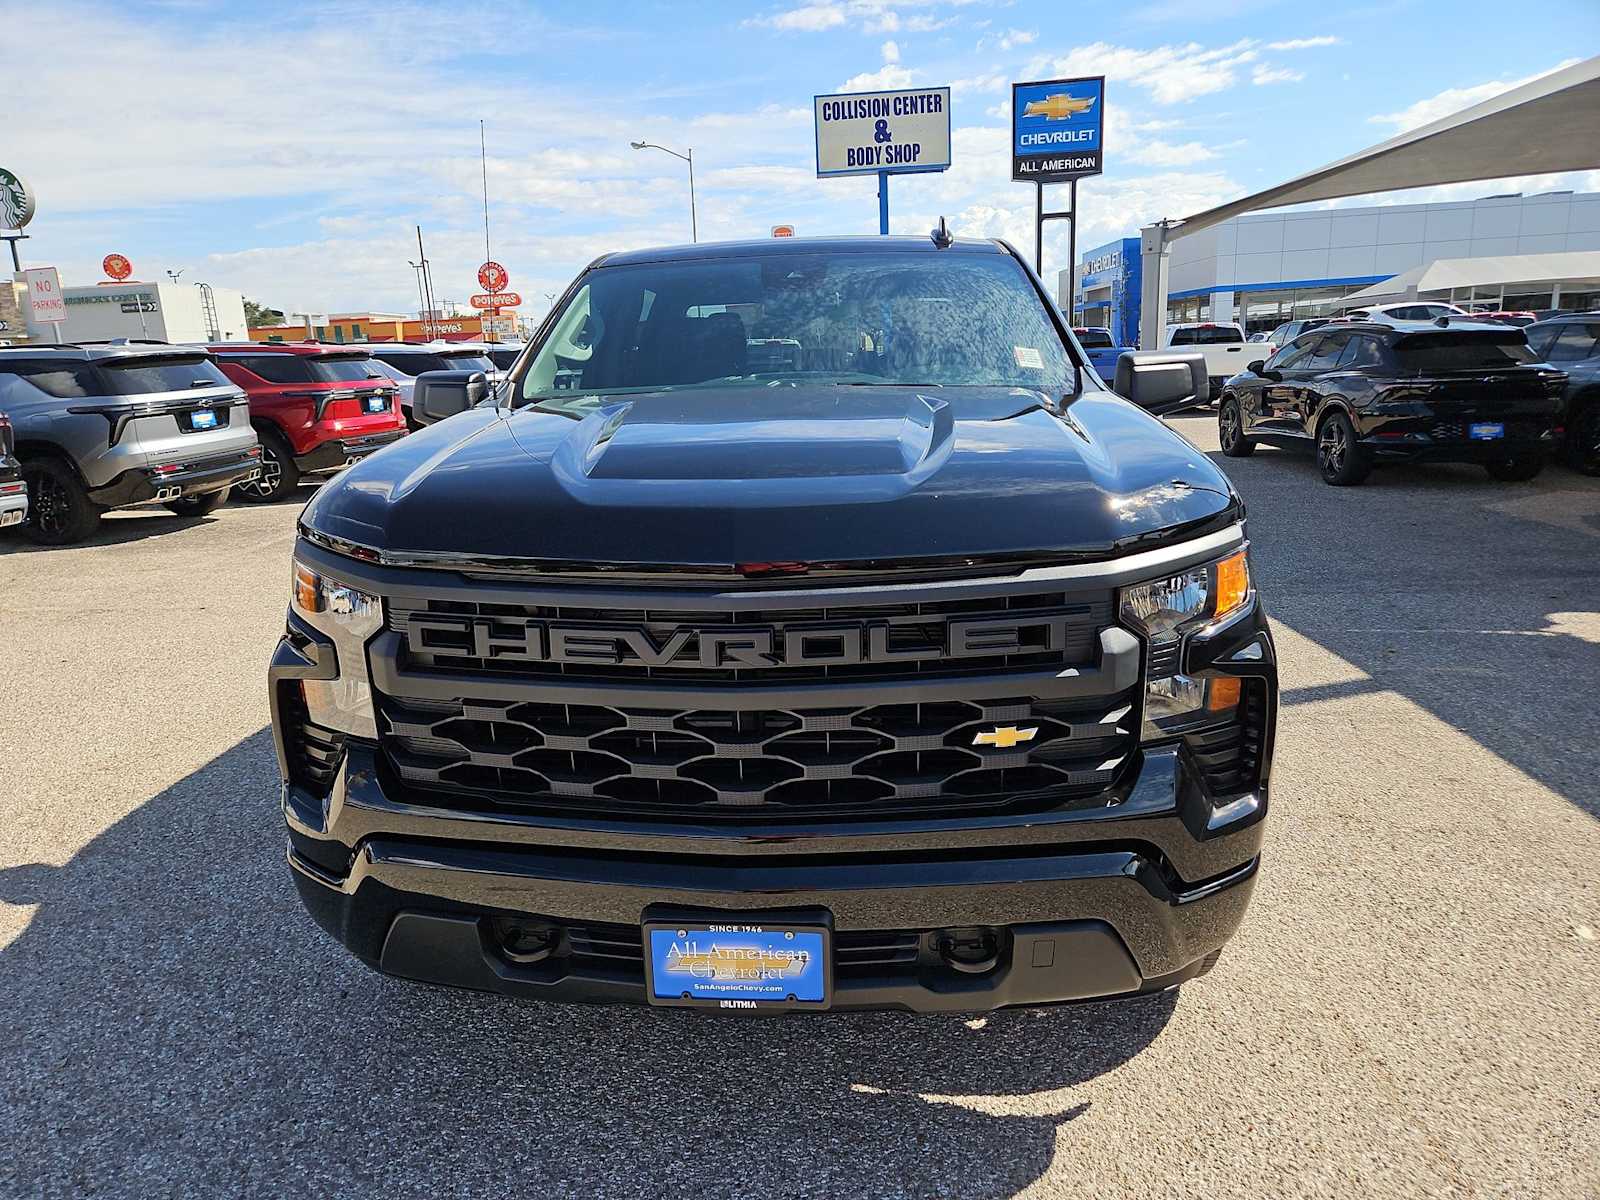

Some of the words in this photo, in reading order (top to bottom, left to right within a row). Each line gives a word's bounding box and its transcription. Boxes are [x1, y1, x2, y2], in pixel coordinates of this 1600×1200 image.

[823, 98, 890, 121] COLLISION
[893, 94, 942, 116] CENTER
[874, 119, 892, 143] &
[1020, 129, 1095, 146] CHEVROLET
[847, 146, 882, 167] BODY
[885, 143, 921, 164] SHOP
[1020, 162, 1039, 172] ALL
[1041, 157, 1096, 171] AMERICAN
[1090, 251, 1121, 274] CHEVROLET
[35, 280, 51, 292] NO
[32, 299, 62, 310] PARKING
[408, 605, 1091, 667] CHEVROLET
[709, 925, 739, 933] SINCE
[742, 925, 763, 933] 1946
[665, 941, 697, 958] All
[707, 943, 812, 961] American
[690, 960, 785, 980] Chevrolet
[694, 983, 783, 993] SanAngeloChevy.com
[728, 1000, 758, 1009] LITHIA
